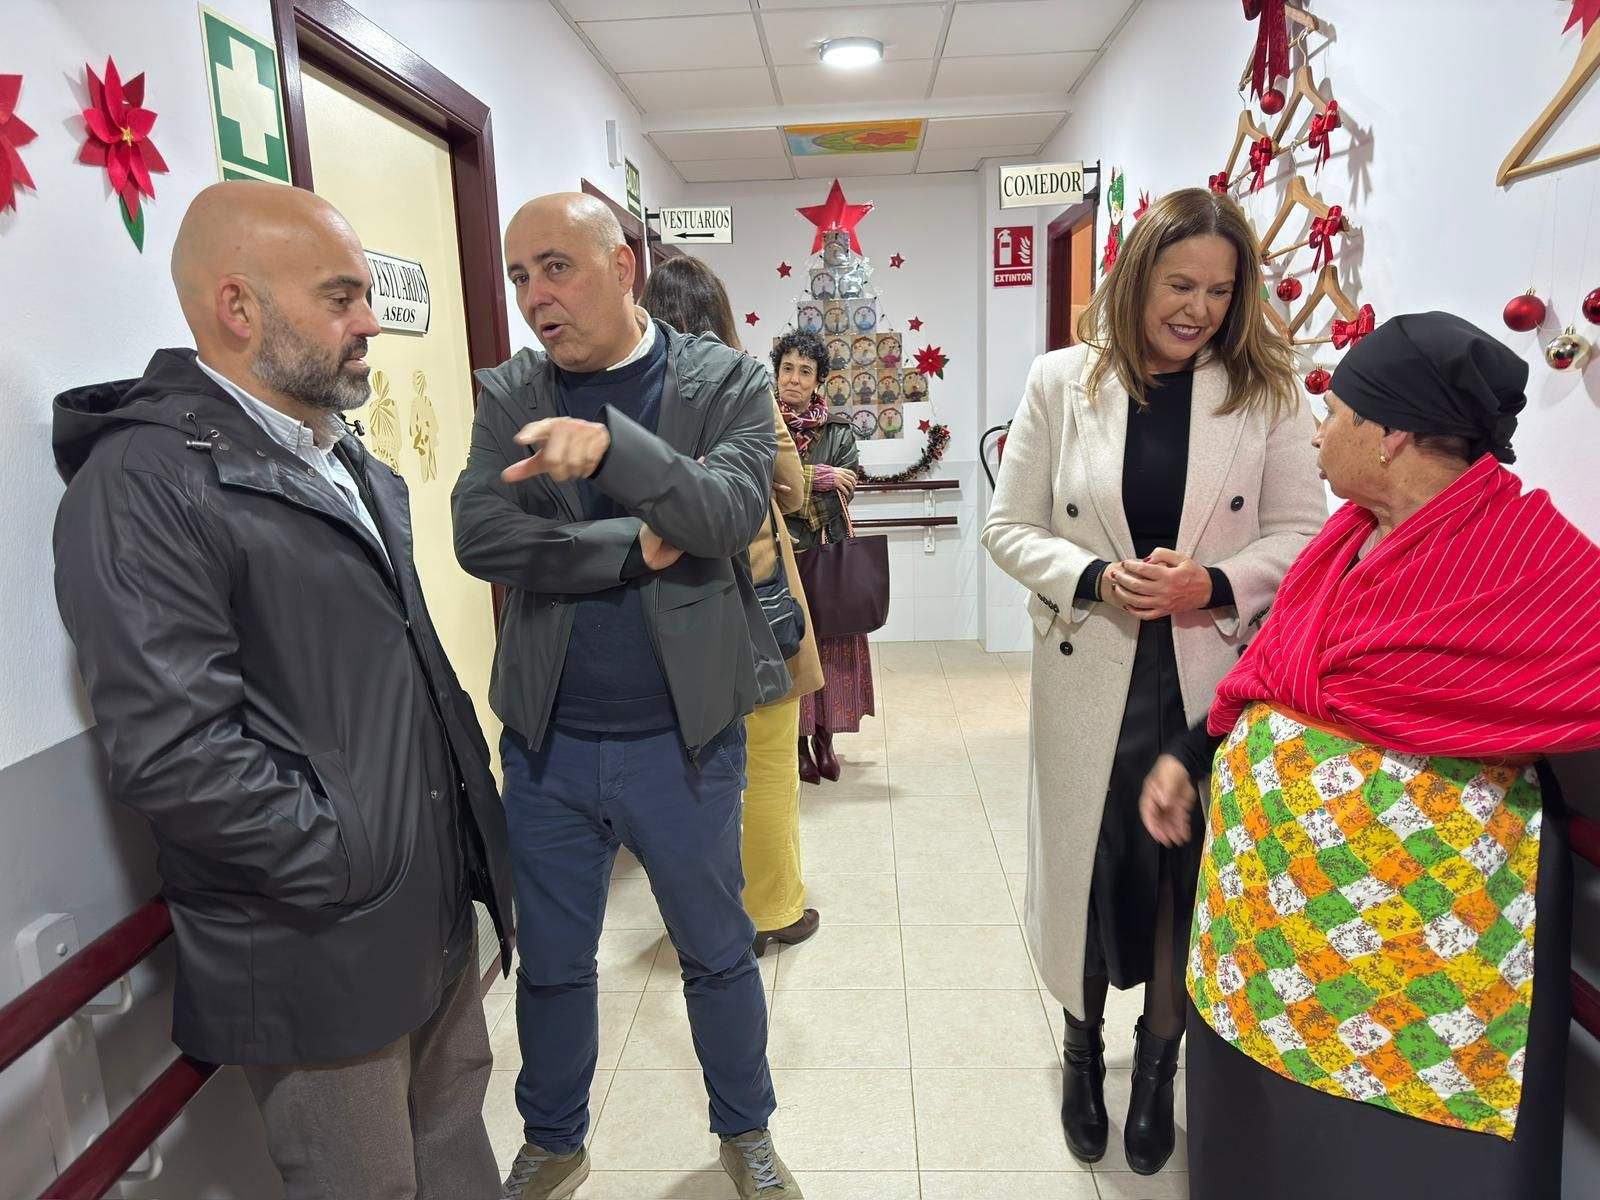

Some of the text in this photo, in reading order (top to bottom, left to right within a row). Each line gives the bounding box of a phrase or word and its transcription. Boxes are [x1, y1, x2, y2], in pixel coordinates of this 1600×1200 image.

[1003, 171, 1082, 197] COMEDOR
[662, 210, 730, 228] VESTUARIOS
[995, 273, 1032, 283] EXTINTOR
[382, 306, 416, 323] ASEOS
